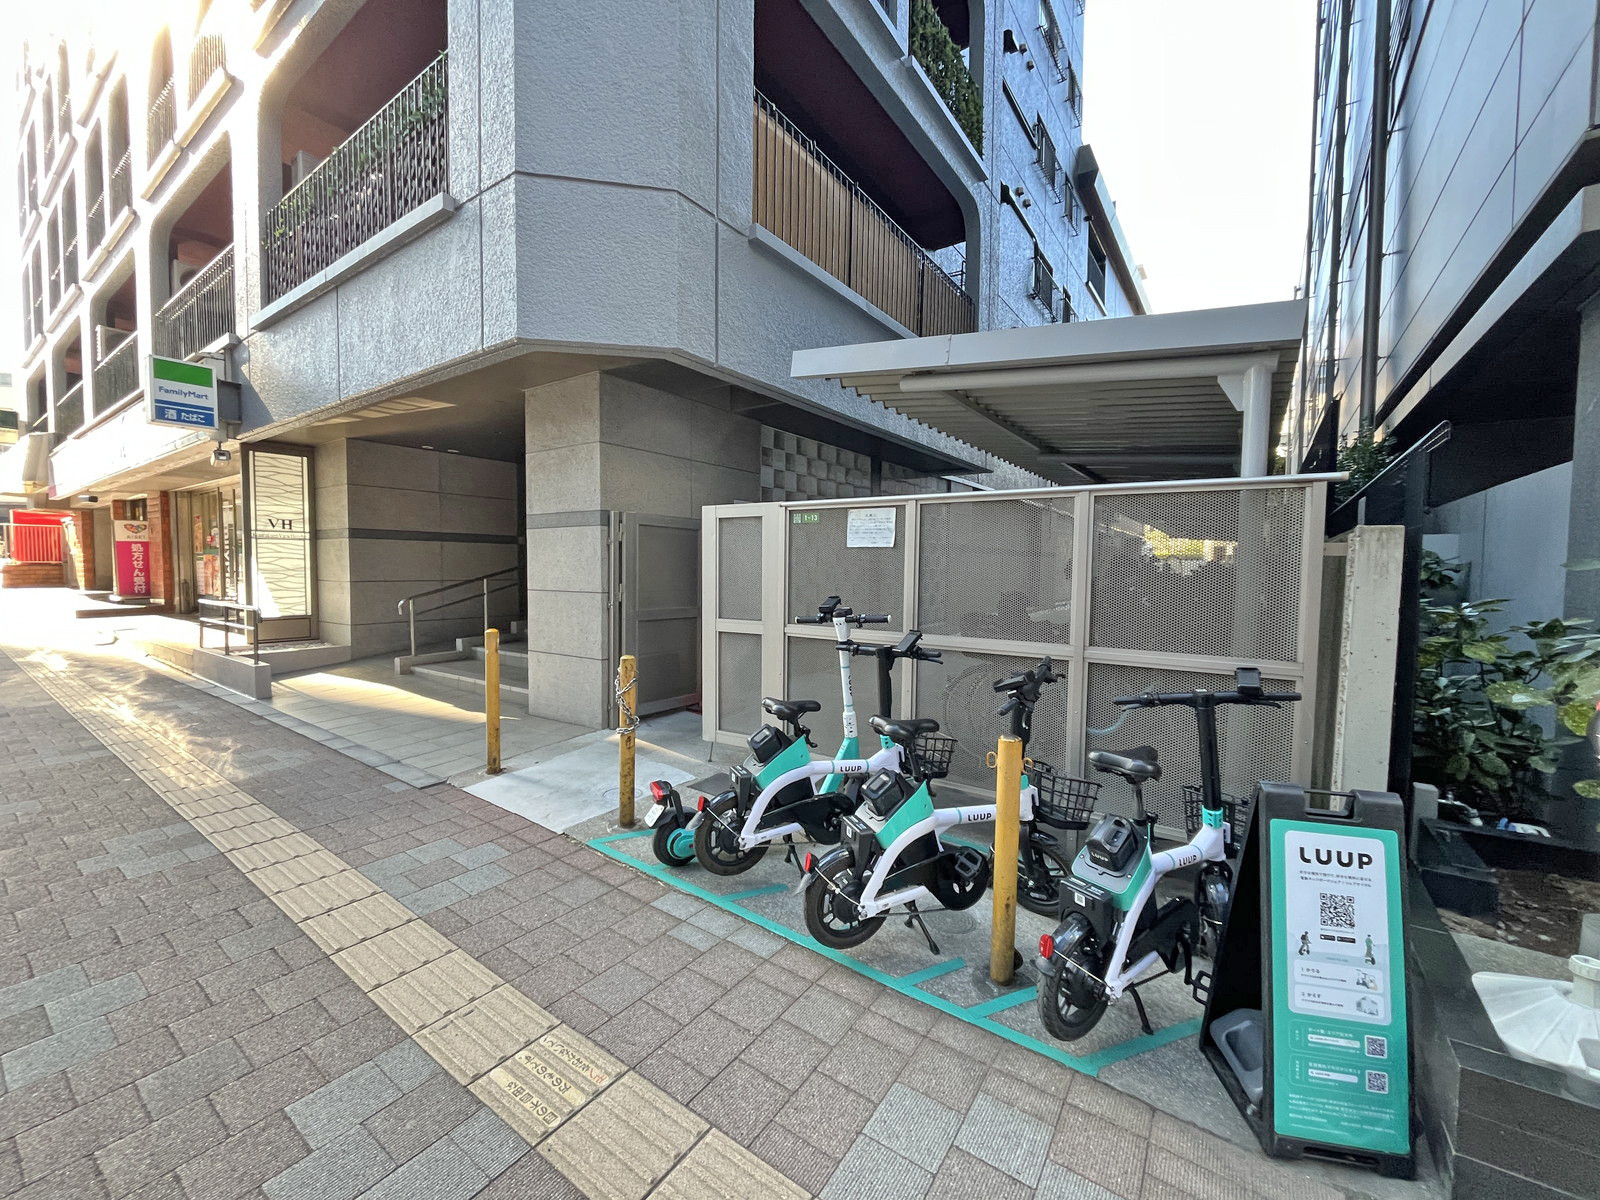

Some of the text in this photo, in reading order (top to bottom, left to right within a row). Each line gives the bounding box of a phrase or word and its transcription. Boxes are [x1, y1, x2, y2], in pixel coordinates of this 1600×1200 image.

[158, 385, 209, 400] FamilyMart
[164, 408, 206, 423] 酒 たばこ
[268, 518, 293, 530] VH
[131, 543, 146, 594] 処方せん受付
[840, 765, 862, 773] LUUP
[967, 813, 992, 821] LUUP
[1178, 854, 1198, 866] LUUP
[1299, 846, 1373, 870] LUUP
[507, 1081, 558, 1125] 目の不自由な
